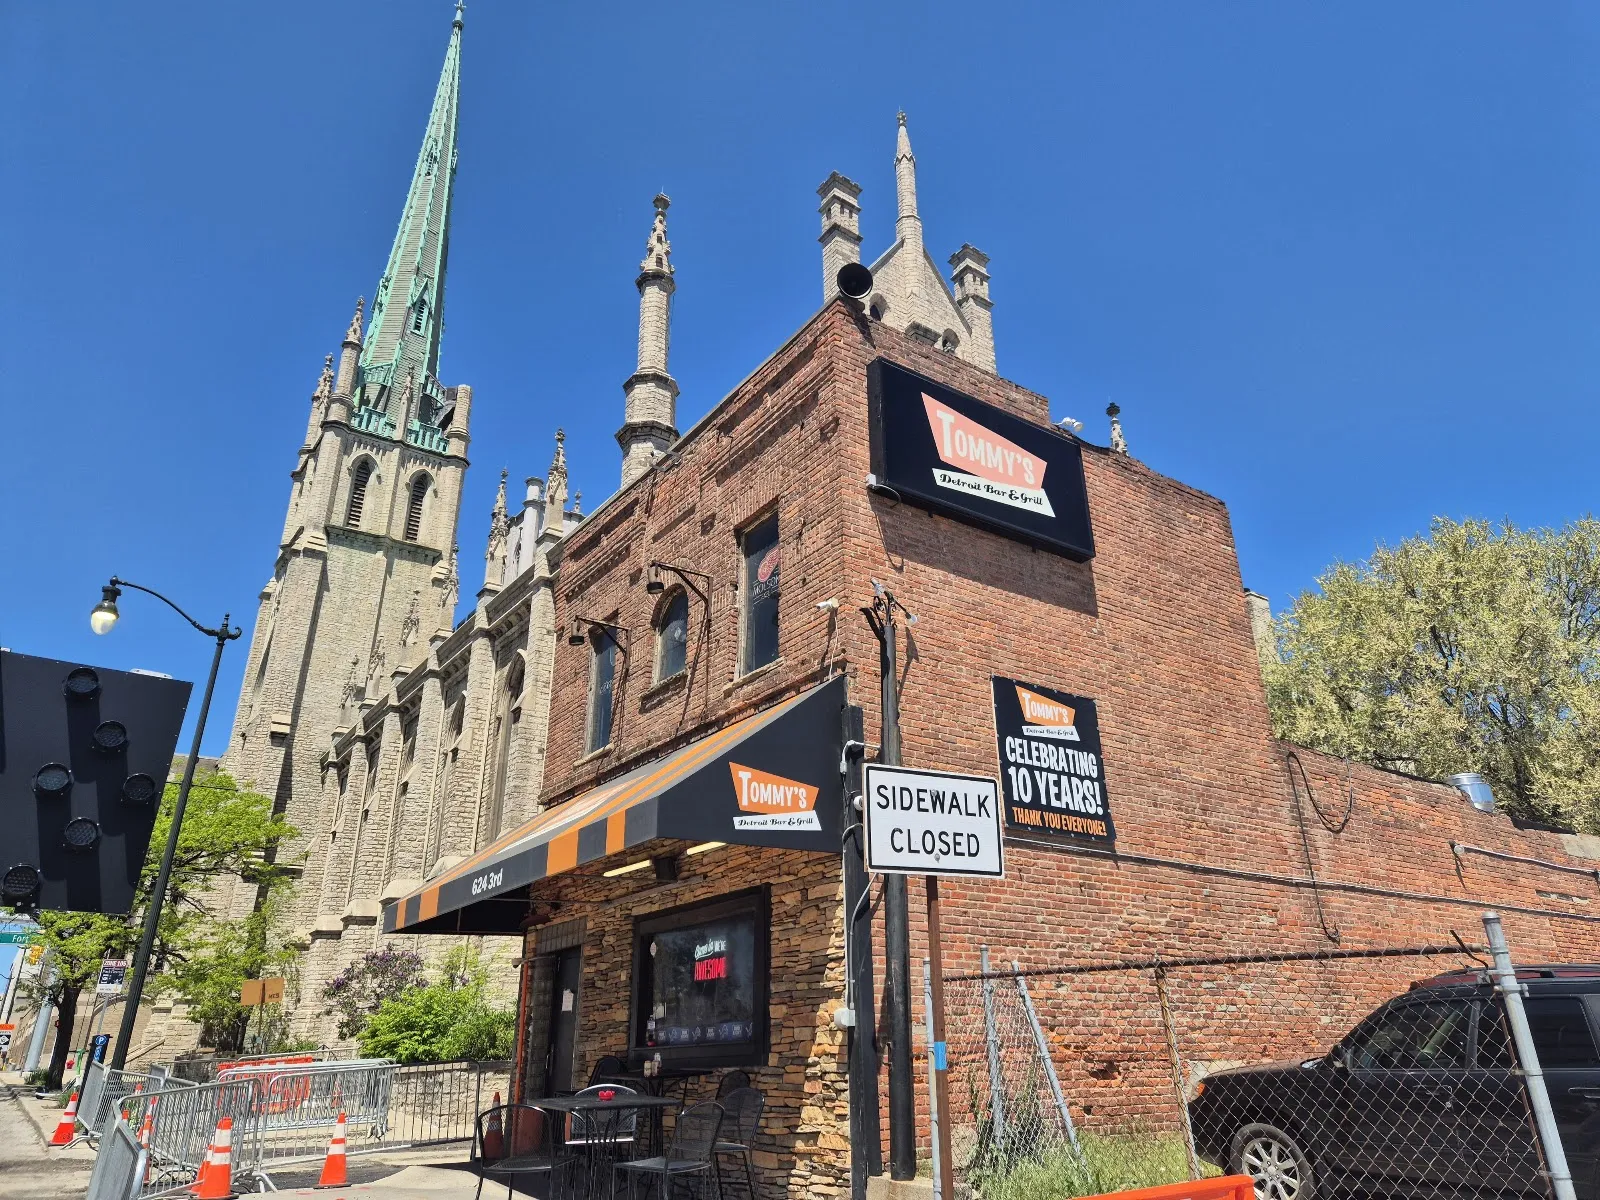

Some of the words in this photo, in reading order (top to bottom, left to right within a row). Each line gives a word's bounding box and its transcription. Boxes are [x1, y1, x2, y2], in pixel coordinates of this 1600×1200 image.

[936, 410, 1035, 485] TOMMY'S
[939, 474, 982, 491] Detroit
[984, 484, 1007, 497] Bar
[1008, 489, 1020, 501] &
[1020, 491, 1044, 506] Grill
[1022, 692, 1069, 724] TOMMY'S
[1005, 736, 1098, 779] CELEBRATING
[738, 771, 807, 809] TOMMY'S
[876, 784, 991, 819] SIDEWALK
[1008, 766, 1032, 804] 10
[1034, 770, 1104, 816] YEARS!
[737, 819, 768, 827] Detroit
[769, 818, 787, 826] Bar
[788, 817, 796, 826] &
[796, 817, 813, 826] Grill
[1012, 806, 1042, 827] THANK
[1043, 813, 1062, 830] YOU
[1061, 813, 1107, 837] EVERYONE!
[890, 827, 980, 858] CLOSED
[472, 875, 487, 895] 624
[488, 868, 503, 889] 3rd
[11, 934, 30, 944] Fort
[694, 956, 727, 981] AWESOME
